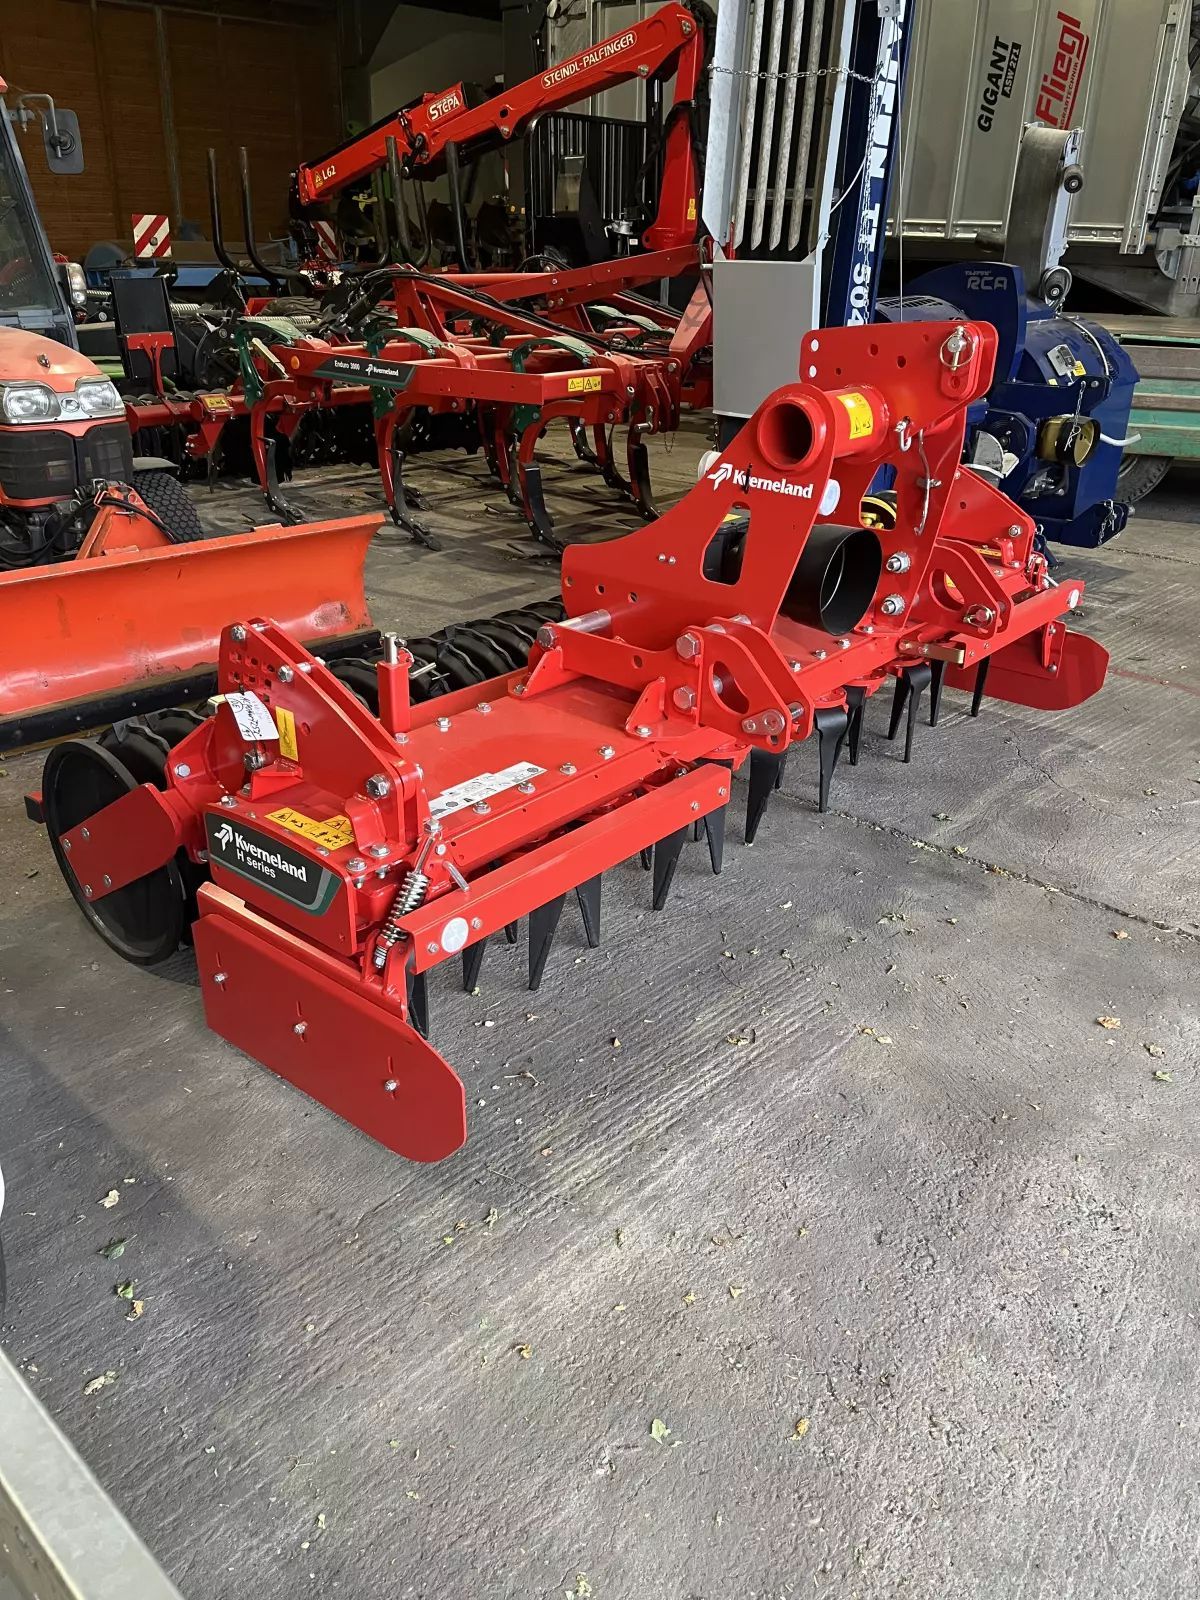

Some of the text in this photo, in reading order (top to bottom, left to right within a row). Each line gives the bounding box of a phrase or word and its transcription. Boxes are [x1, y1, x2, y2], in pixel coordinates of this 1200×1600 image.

[543, 33, 634, 87] STEINDL-PALFINGER
[1003, 48, 1020, 94] ASW 271
[1035, 10, 1085, 127] Fliegl
[977, 35, 1010, 132] GIGANT
[429, 95, 460, 121] STEPA
[321, 165, 337, 180] L62
[846, 262, 872, 327] 504
[967, 275, 1008, 290] RCA
[732, 469, 814, 498] Kverneland
[234, 832, 308, 883] Kverneland
[236, 848, 277, 879] H series
